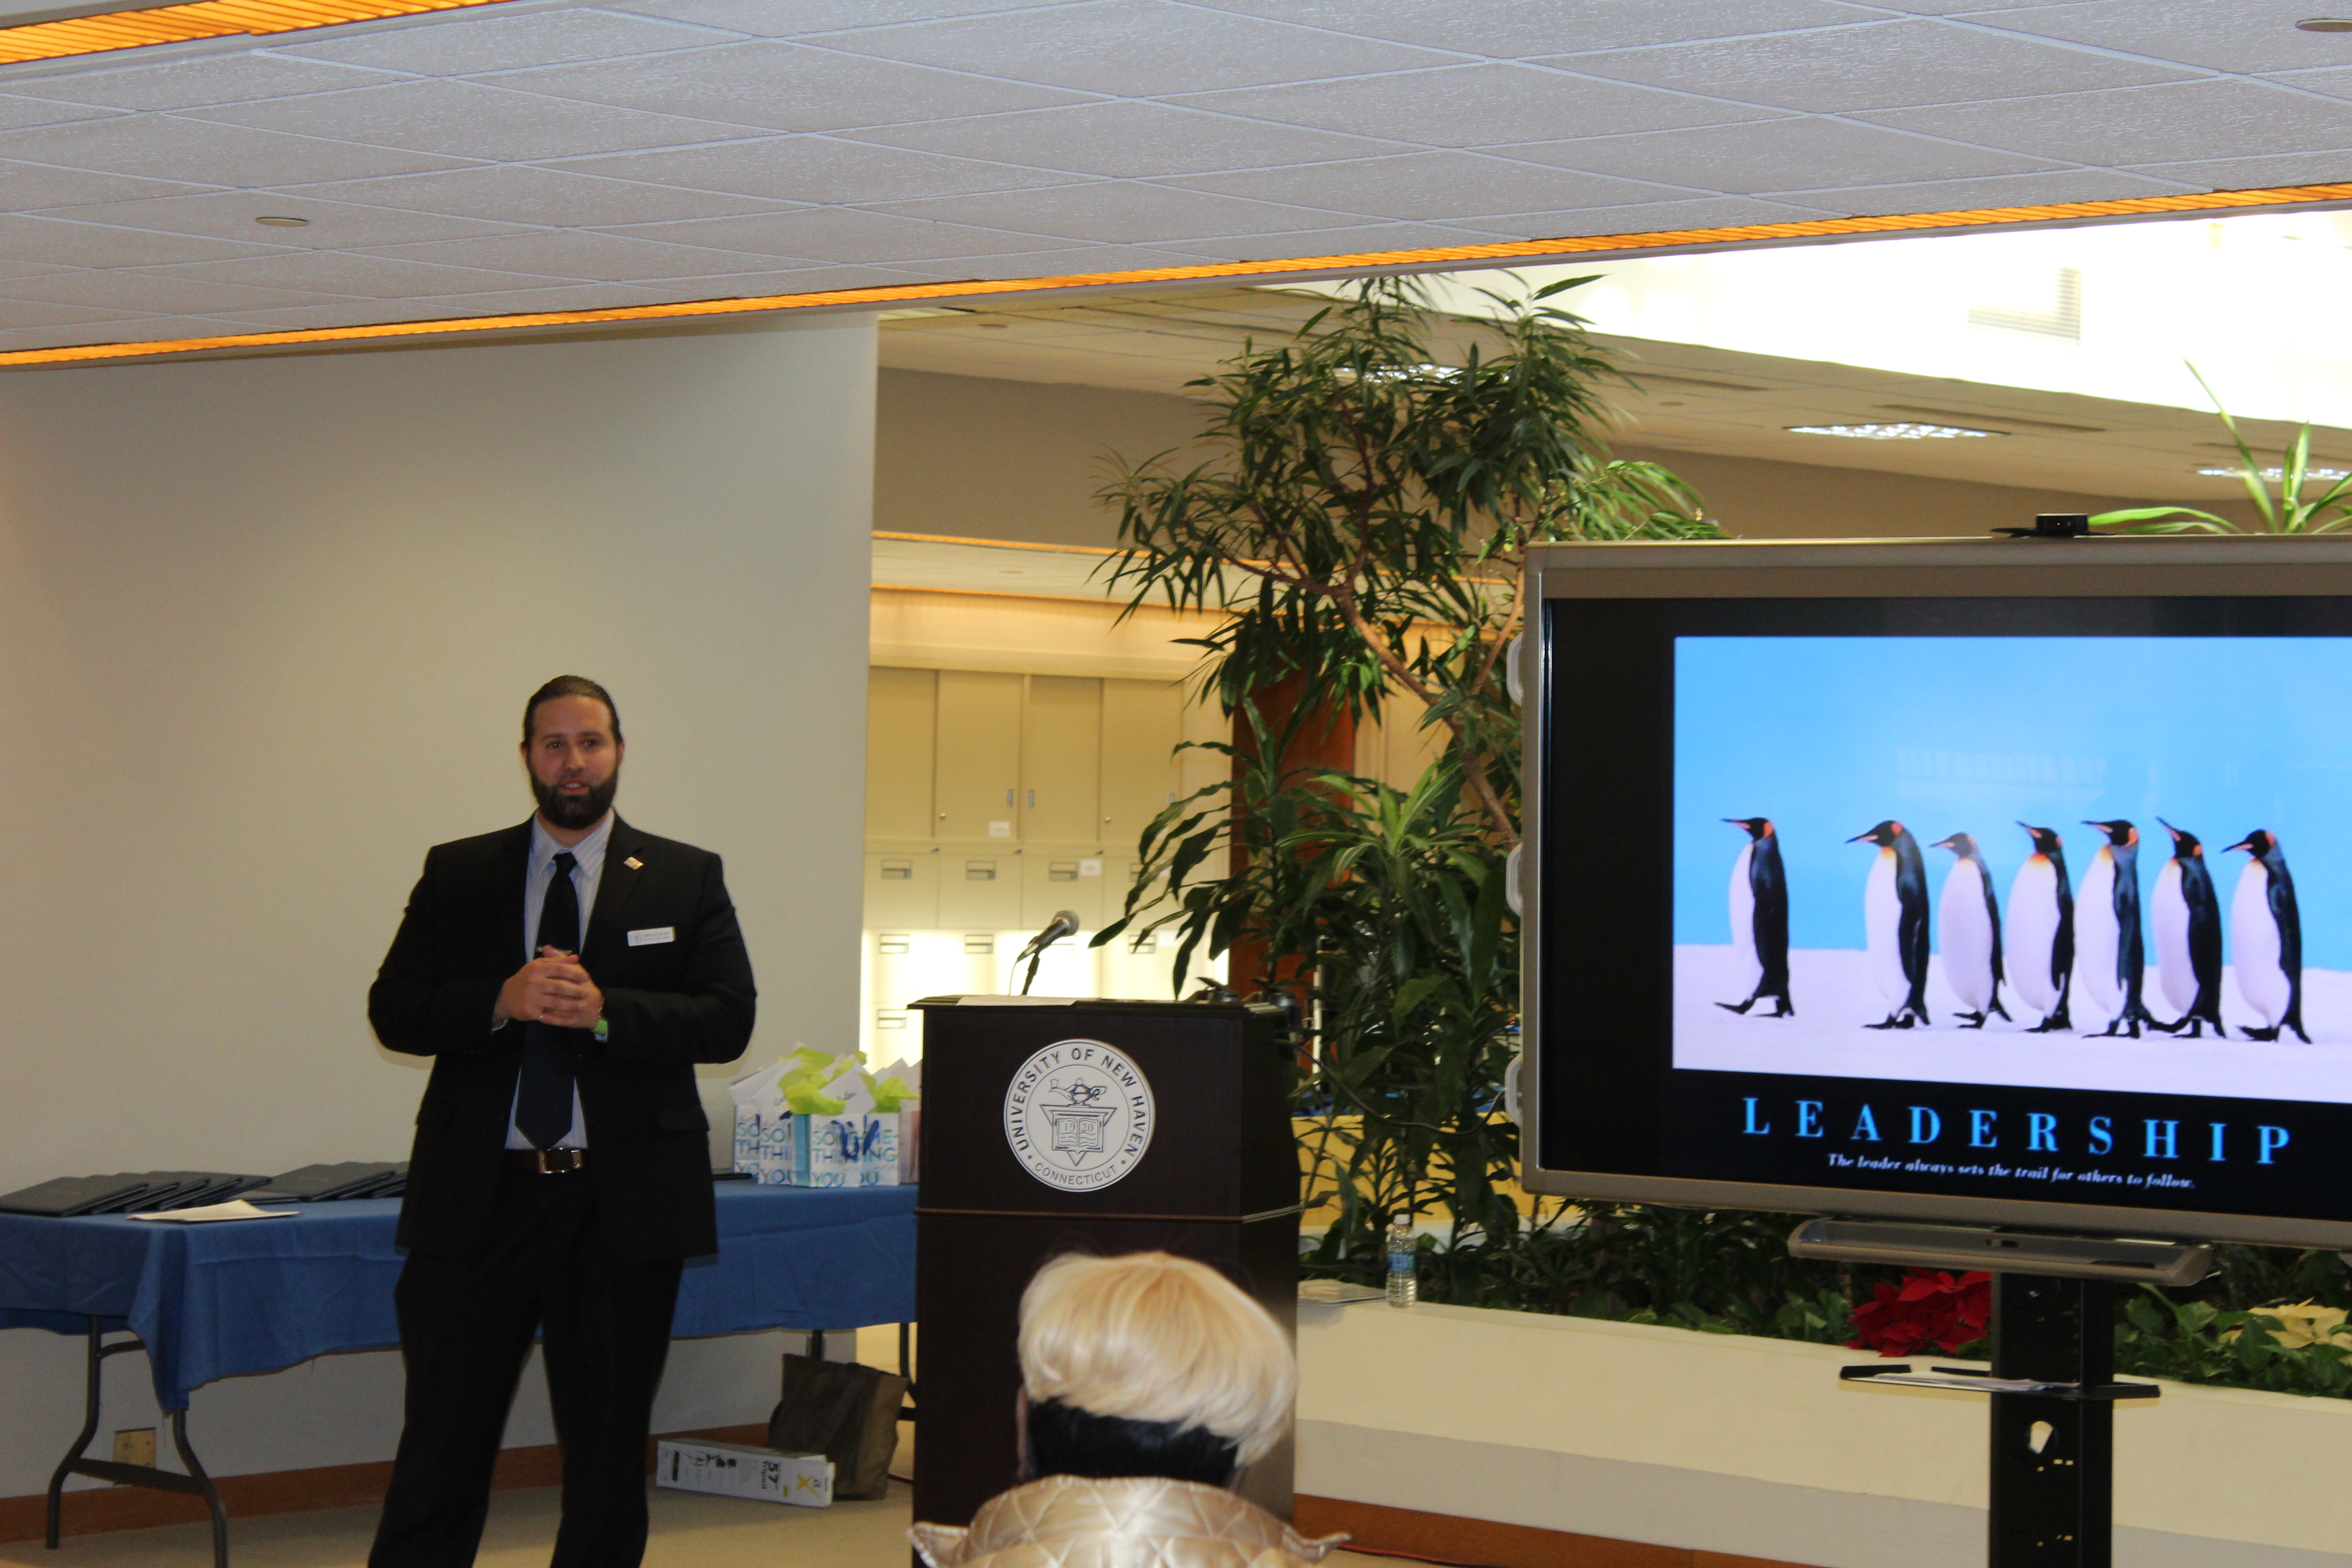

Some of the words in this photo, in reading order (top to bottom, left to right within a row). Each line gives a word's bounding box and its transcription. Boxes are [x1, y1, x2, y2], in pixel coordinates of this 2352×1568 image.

[1010, 1051, 1060, 1152] UNIVERSITY
[1071, 1048, 1094, 1061] OF
[1101, 1055, 1136, 1088] NEW
[1124, 1095, 1146, 1157] HAVEN
[1743, 1097, 2290, 1165] LEADERSHIP
[1034, 1162, 1117, 1185] CONNECTICUT
[1828, 1153, 1854, 1166] The
[1857, 1155, 1902, 1169] leader
[1905, 1158, 1955, 1176] always
[1958, 1165, 1985, 1175] sets
[1988, 1163, 2011, 1176] the
[2015, 1166, 2049, 1179] trail
[2050, 1167, 2074, 1183] for
[2077, 1169, 2123, 1183] others
[2127, 1174, 2143, 1185] to
